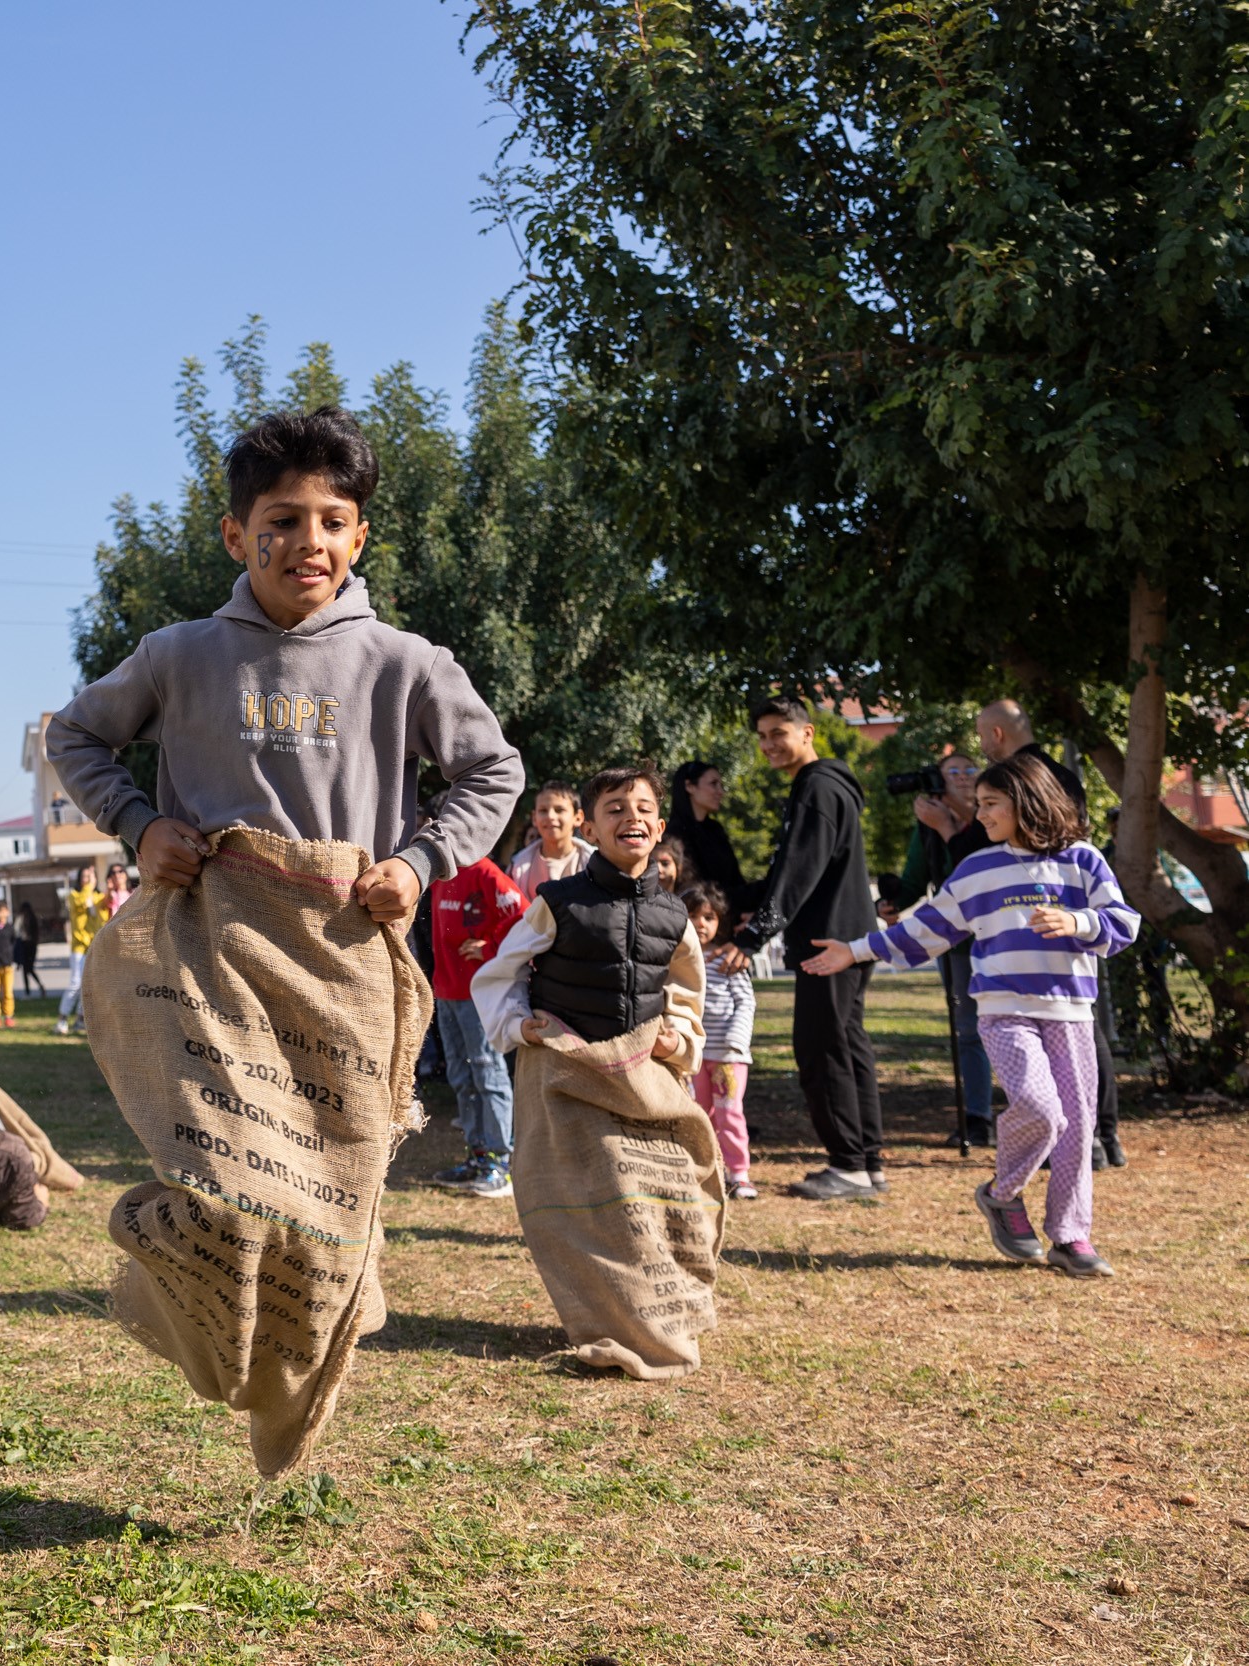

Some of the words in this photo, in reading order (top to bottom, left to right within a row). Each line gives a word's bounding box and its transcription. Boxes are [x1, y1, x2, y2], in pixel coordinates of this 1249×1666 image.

[240, 690, 340, 736] HOPE
[240, 731, 265, 741] KEEP
[270, 734, 298, 744] YOUR
[303, 736, 337, 748] DREAM
[273, 743, 302, 754] ALIVE
[135, 983, 177, 1002] Green
[184, 1039, 235, 1067] CROP
[200, 1087, 280, 1134] ORIGIN:
[282, 1120, 325, 1153] Brazil
[175, 1123, 239, 1163] PROD.
[245, 1149, 290, 1183] DATE
[618, 1161, 661, 1181] ORIGIN:
[178, 1168, 230, 1205] EXP.
[236, 1192, 280, 1225] DATE
[637, 1181, 694, 1203] PRODUCT:
[157, 1202, 189, 1240] NET
[304, 1299, 326, 1313] KG
[282, 1254, 327, 1282] 60.50
[329, 1271, 348, 1284] KG
[638, 1300, 683, 1320] GROSS
